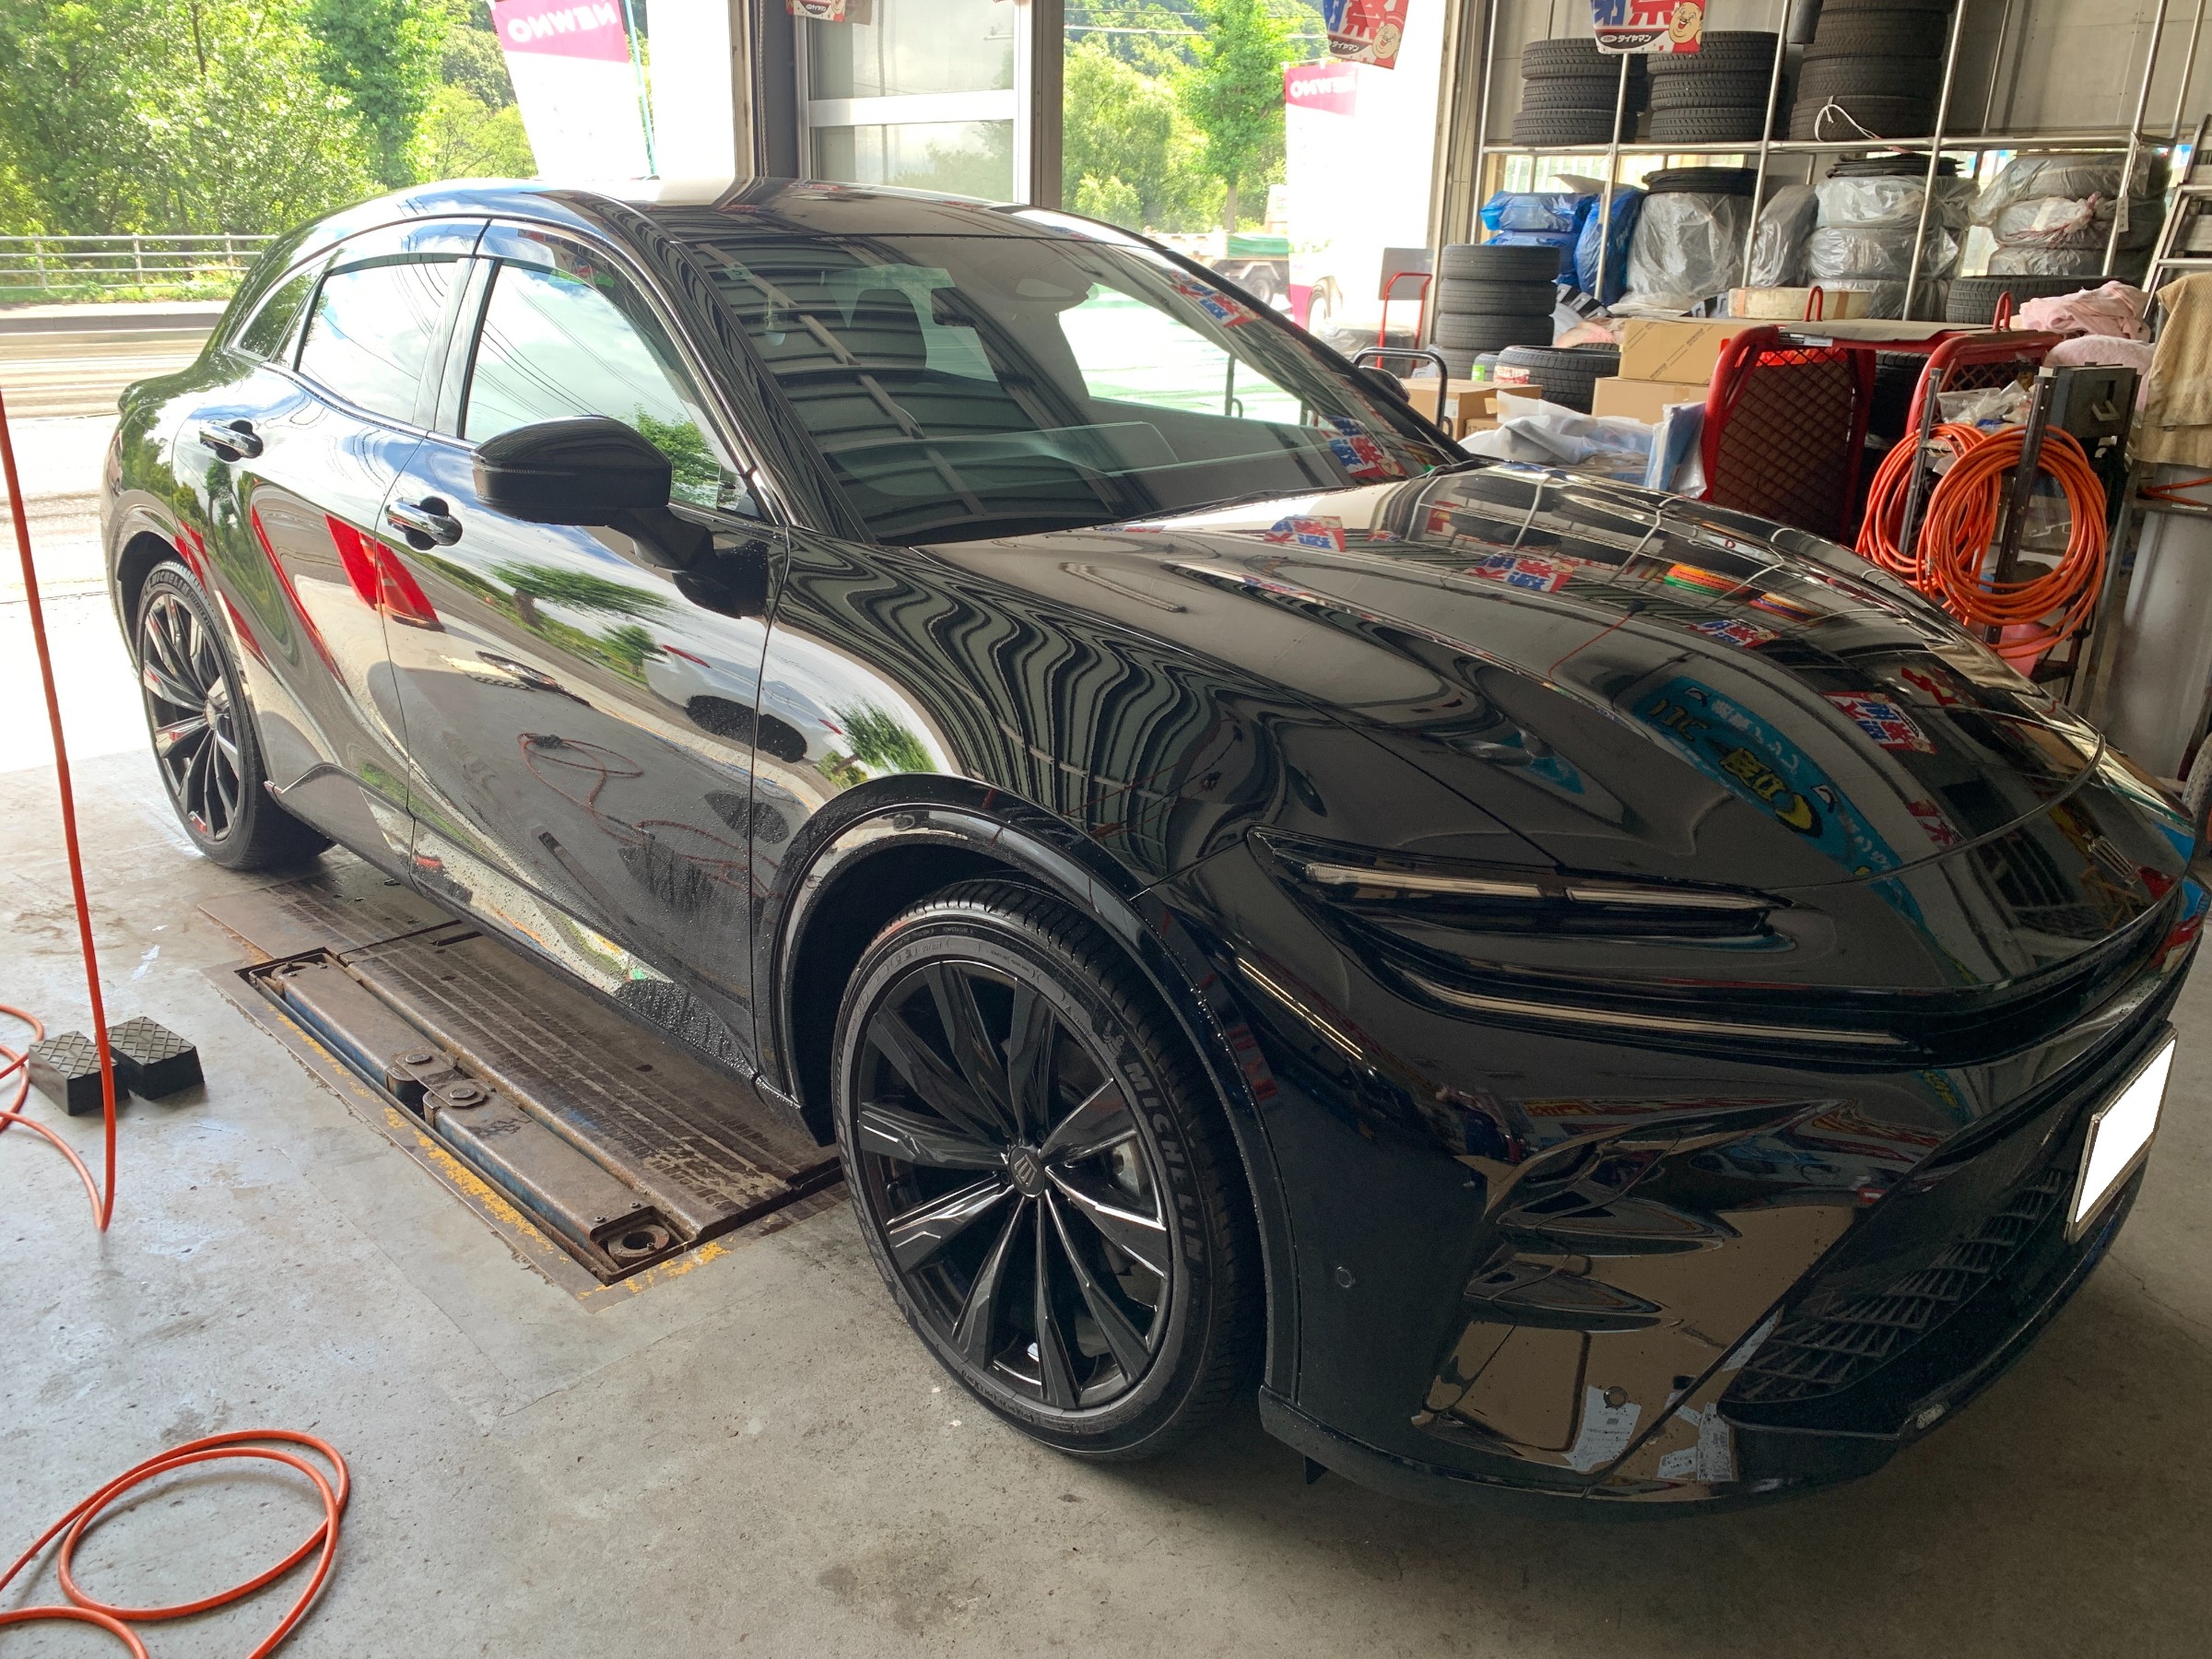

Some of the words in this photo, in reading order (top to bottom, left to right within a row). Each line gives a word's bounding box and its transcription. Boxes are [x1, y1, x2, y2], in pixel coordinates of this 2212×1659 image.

[1332, 41, 1359, 52] タイヤマン
[1617, 34, 1652, 42] タイヤマン
[150, 571, 190, 595] MICHELIN
[1124, 1062, 1204, 1263] MICHELIN
